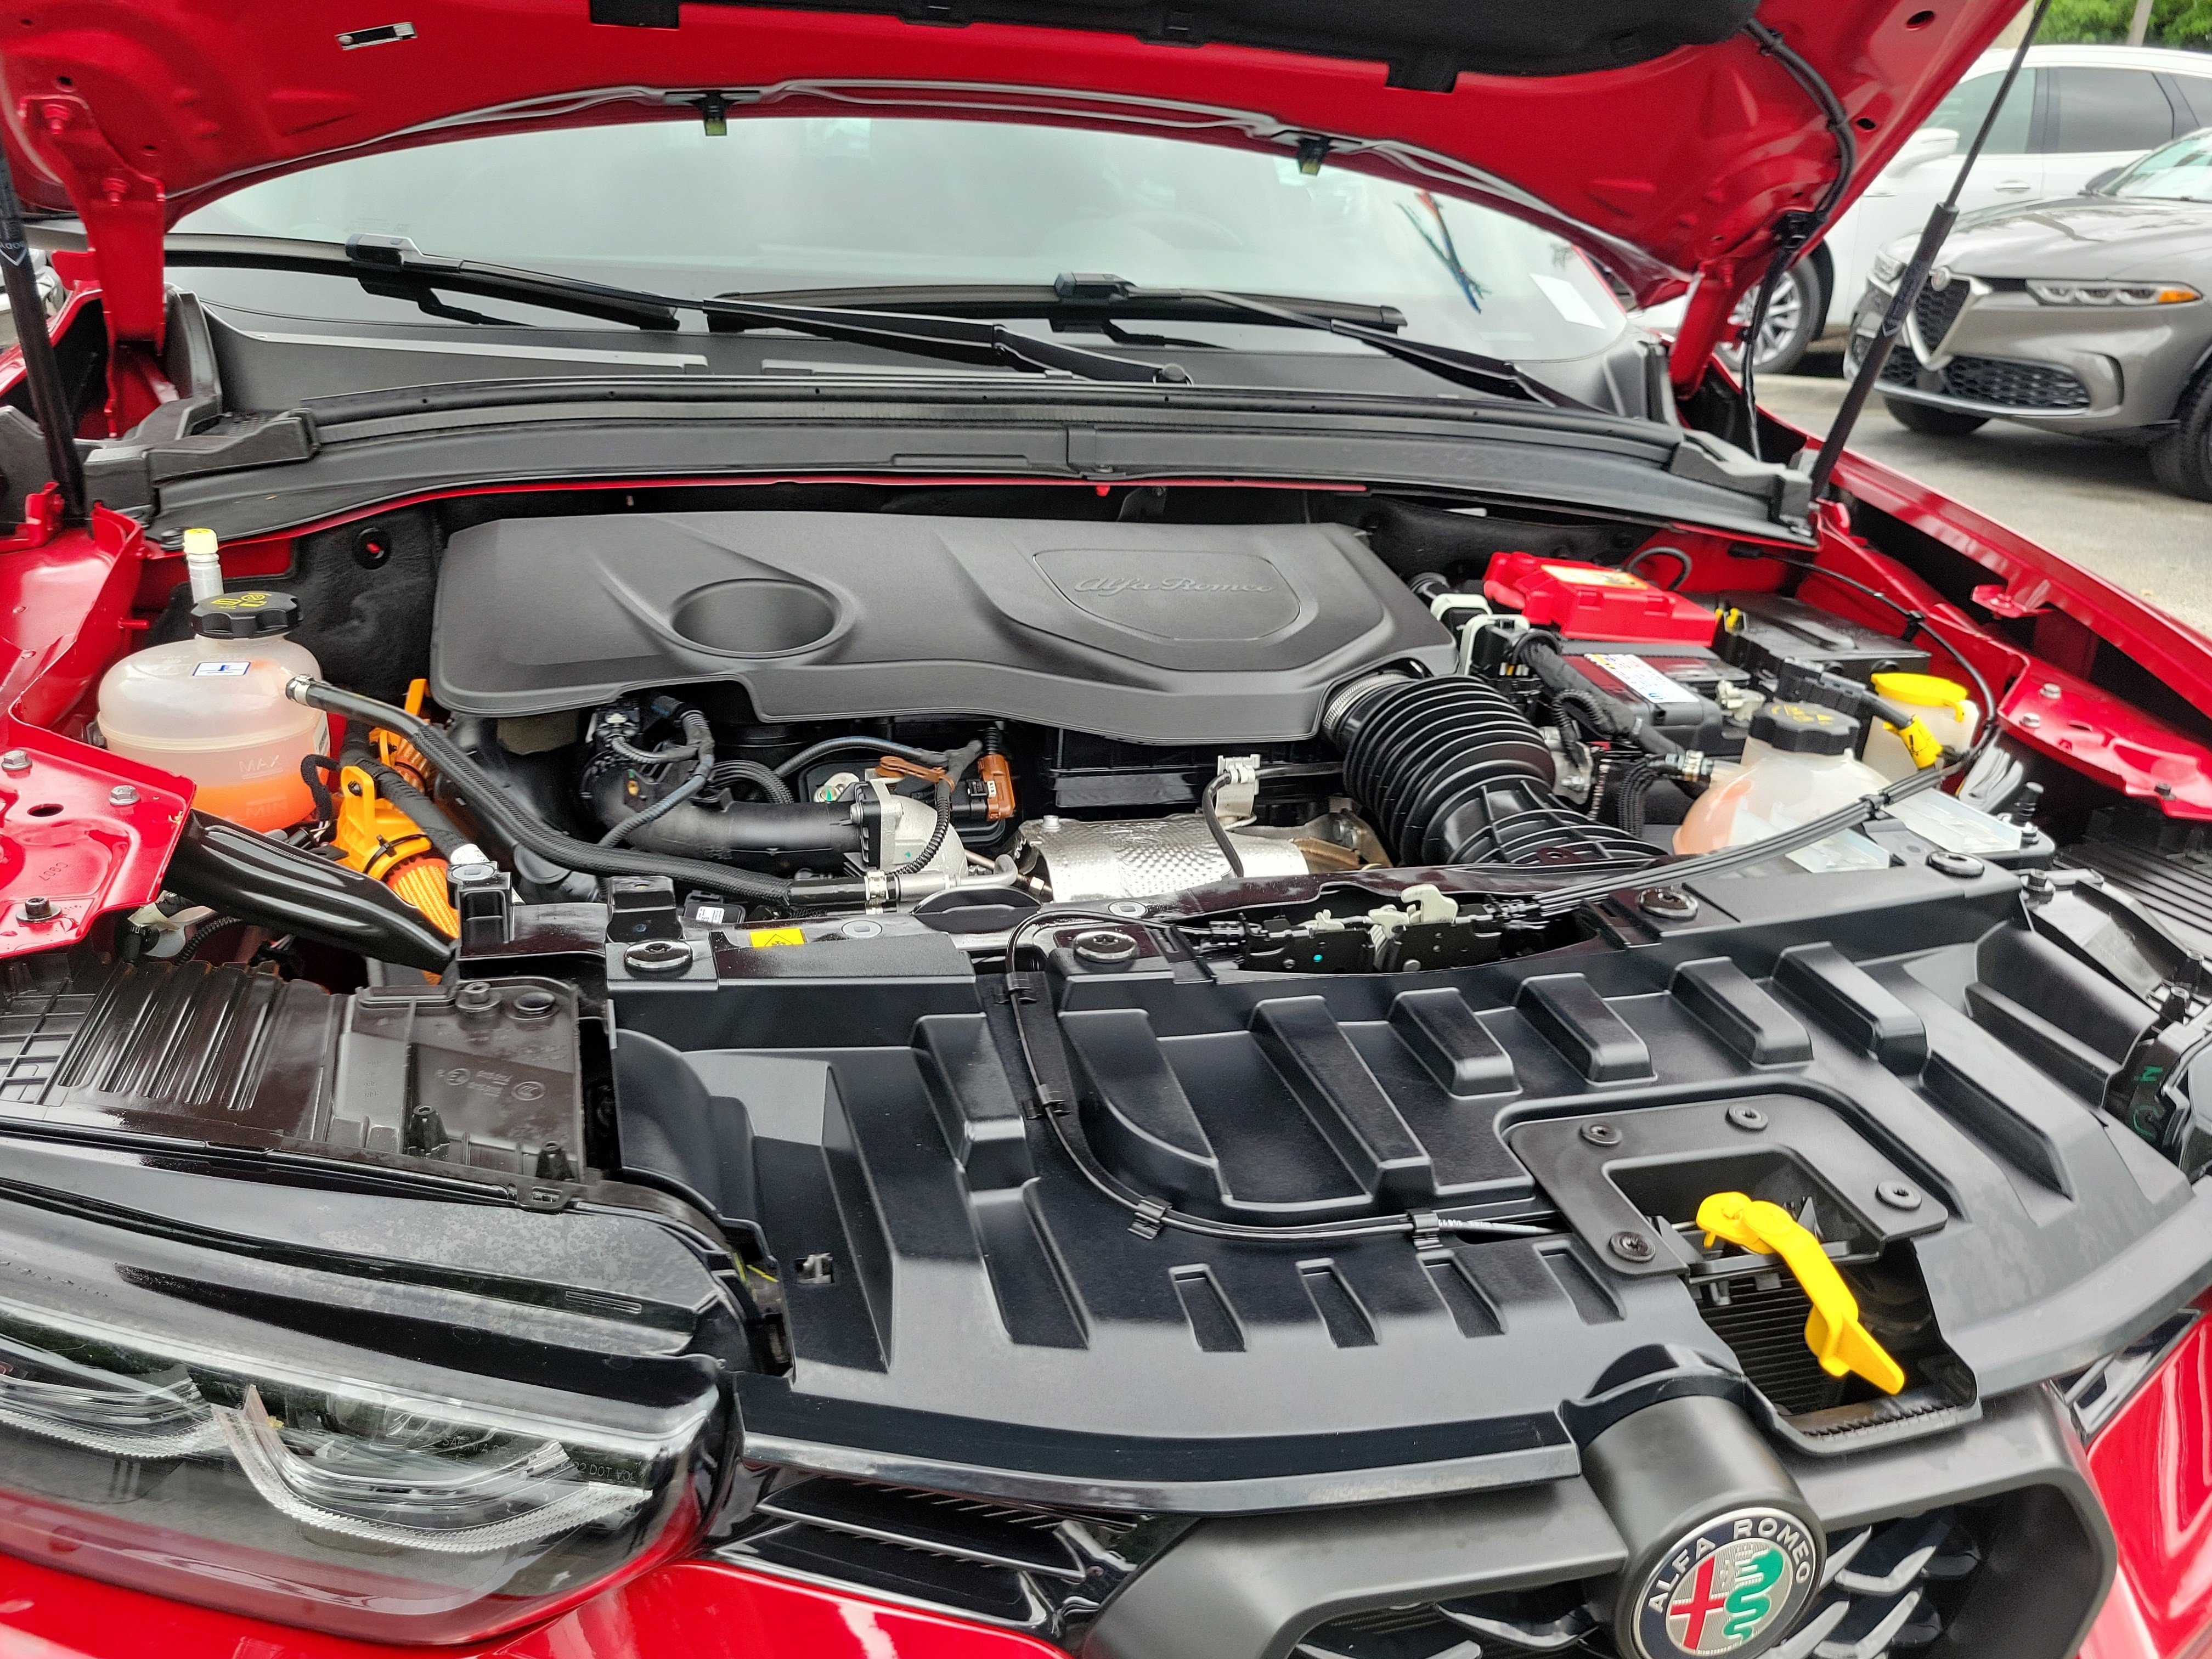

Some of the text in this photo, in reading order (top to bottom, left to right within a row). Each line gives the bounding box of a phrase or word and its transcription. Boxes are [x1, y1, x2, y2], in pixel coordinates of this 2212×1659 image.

[1074, 577, 1272, 597] Alfa Romeo
[238, 754, 281, 773] MAX
[589, 1463, 613, 1478] DOT
[1647, 1517, 1811, 1614] ALFA ROMEO
